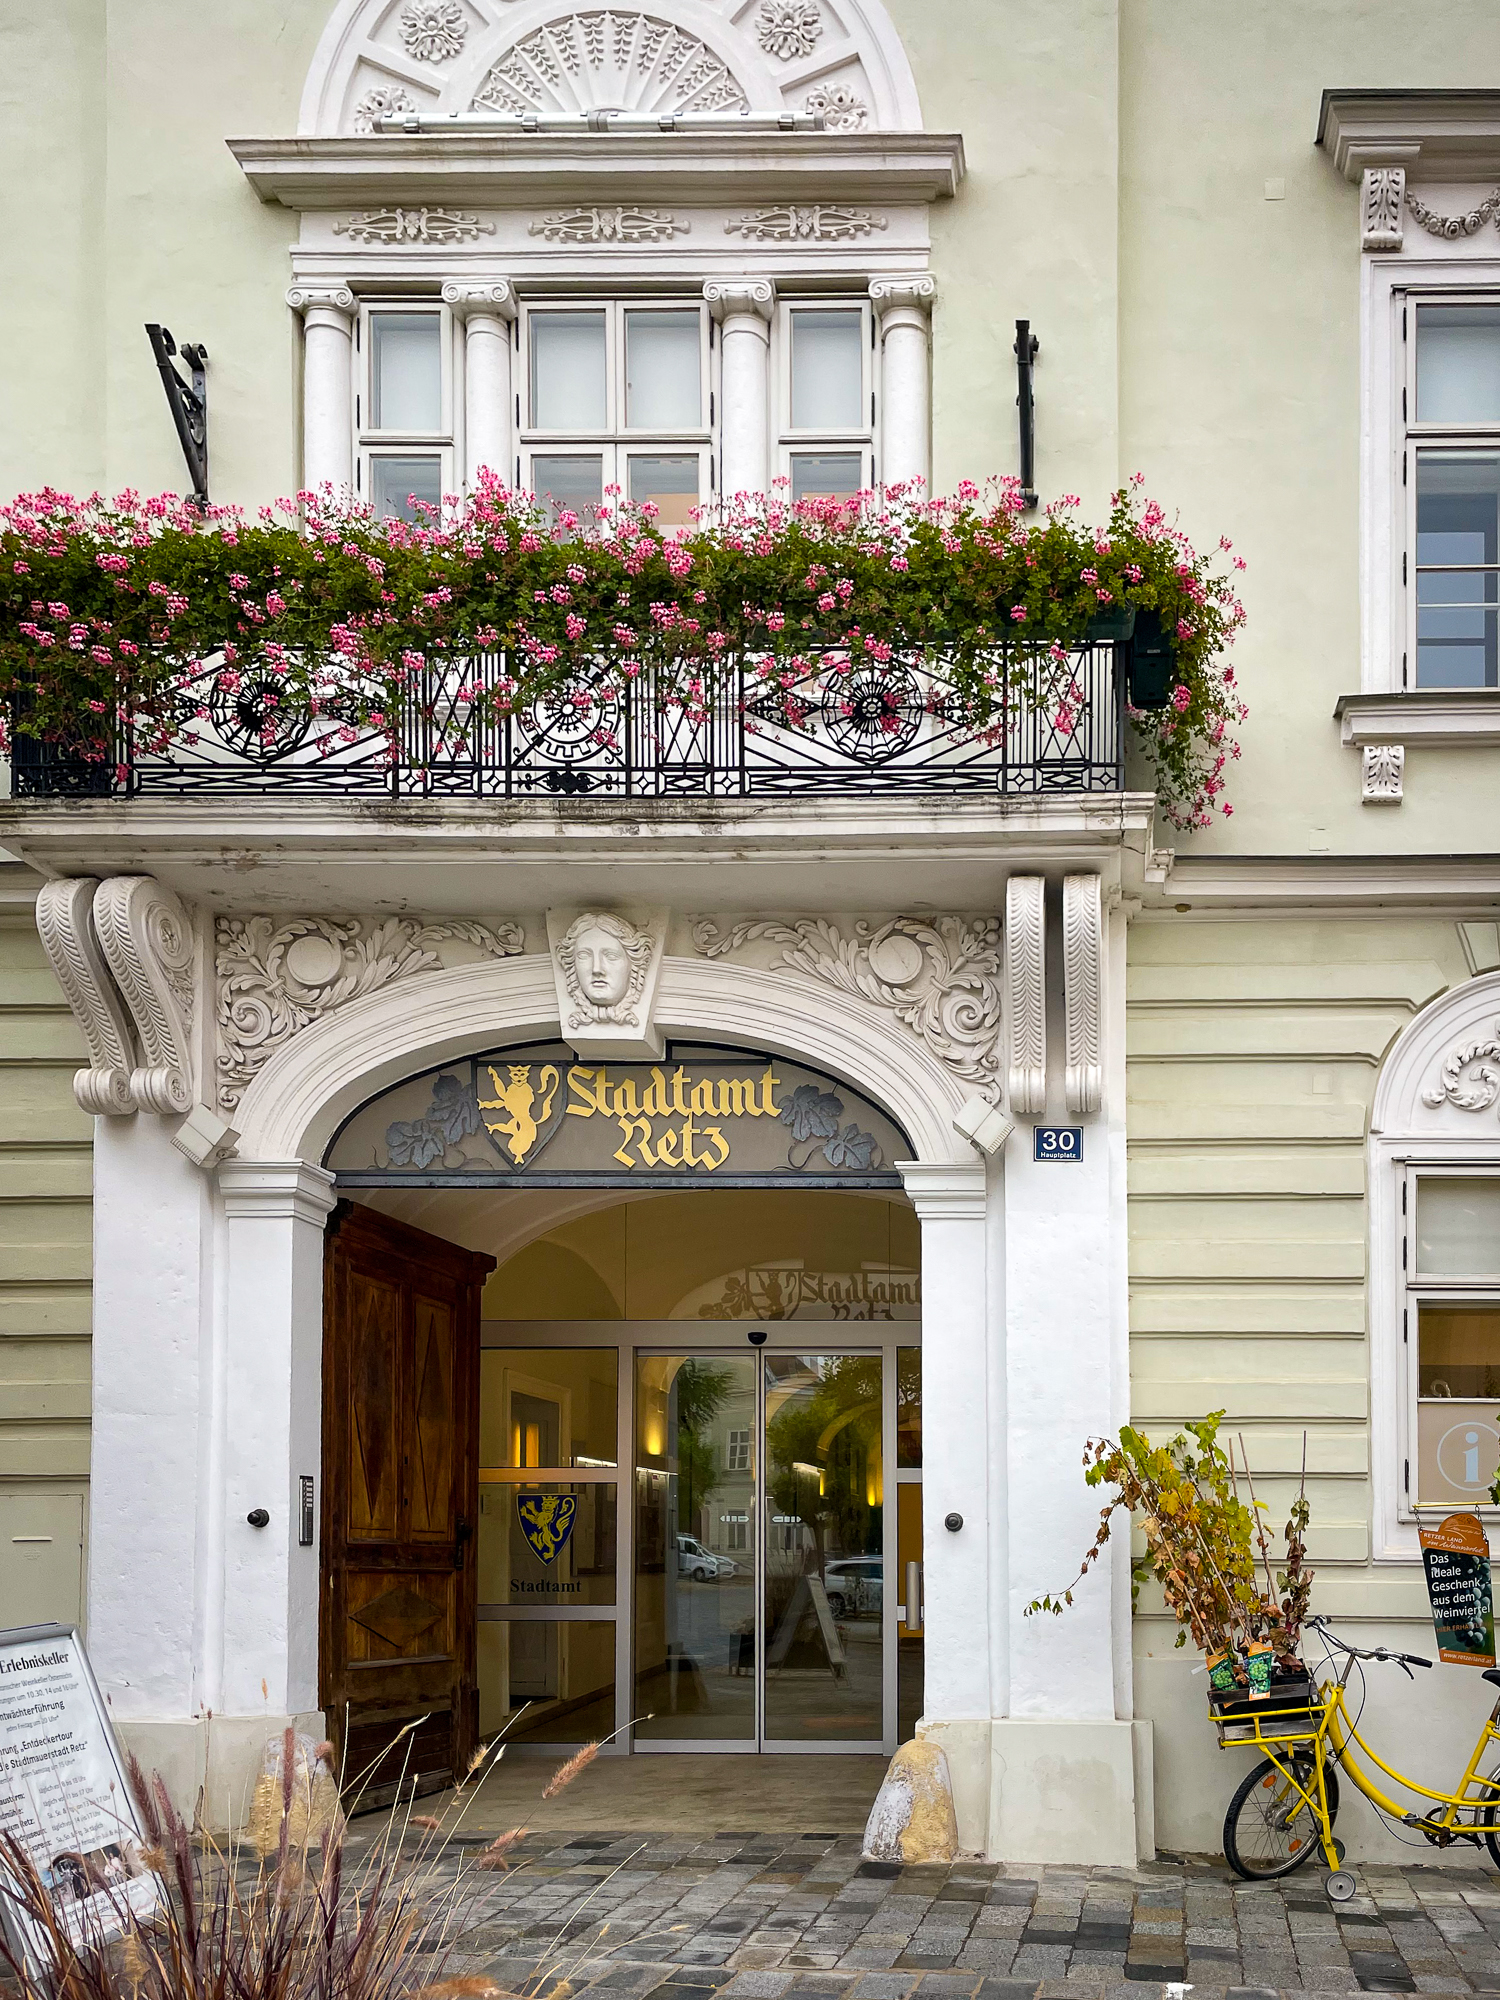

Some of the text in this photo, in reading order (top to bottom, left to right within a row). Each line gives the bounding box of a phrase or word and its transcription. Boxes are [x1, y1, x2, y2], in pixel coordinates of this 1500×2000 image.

[566, 1064, 783, 1118] Stadtamt
[612, 1113, 731, 1171] Retz
[1042, 1131, 1075, 1150] 30
[1040, 1151, 1077, 1159] Hauptplatz
[1423, 1532, 1446, 1540] RETZER
[1429, 1554, 1450, 1565] Das
[1430, 1566, 1462, 1578] ideale
[510, 1578, 582, 1593] Stadtamt
[1431, 1577, 1481, 1592] Geschenk
[1432, 1593, 1475, 1606] aus dem
[1433, 1603, 1491, 1619] Weinviertel
[0, 1651, 69, 1674] Erlebniskeller
[1443, 1652, 1492, 1664] www.retzerland.at
